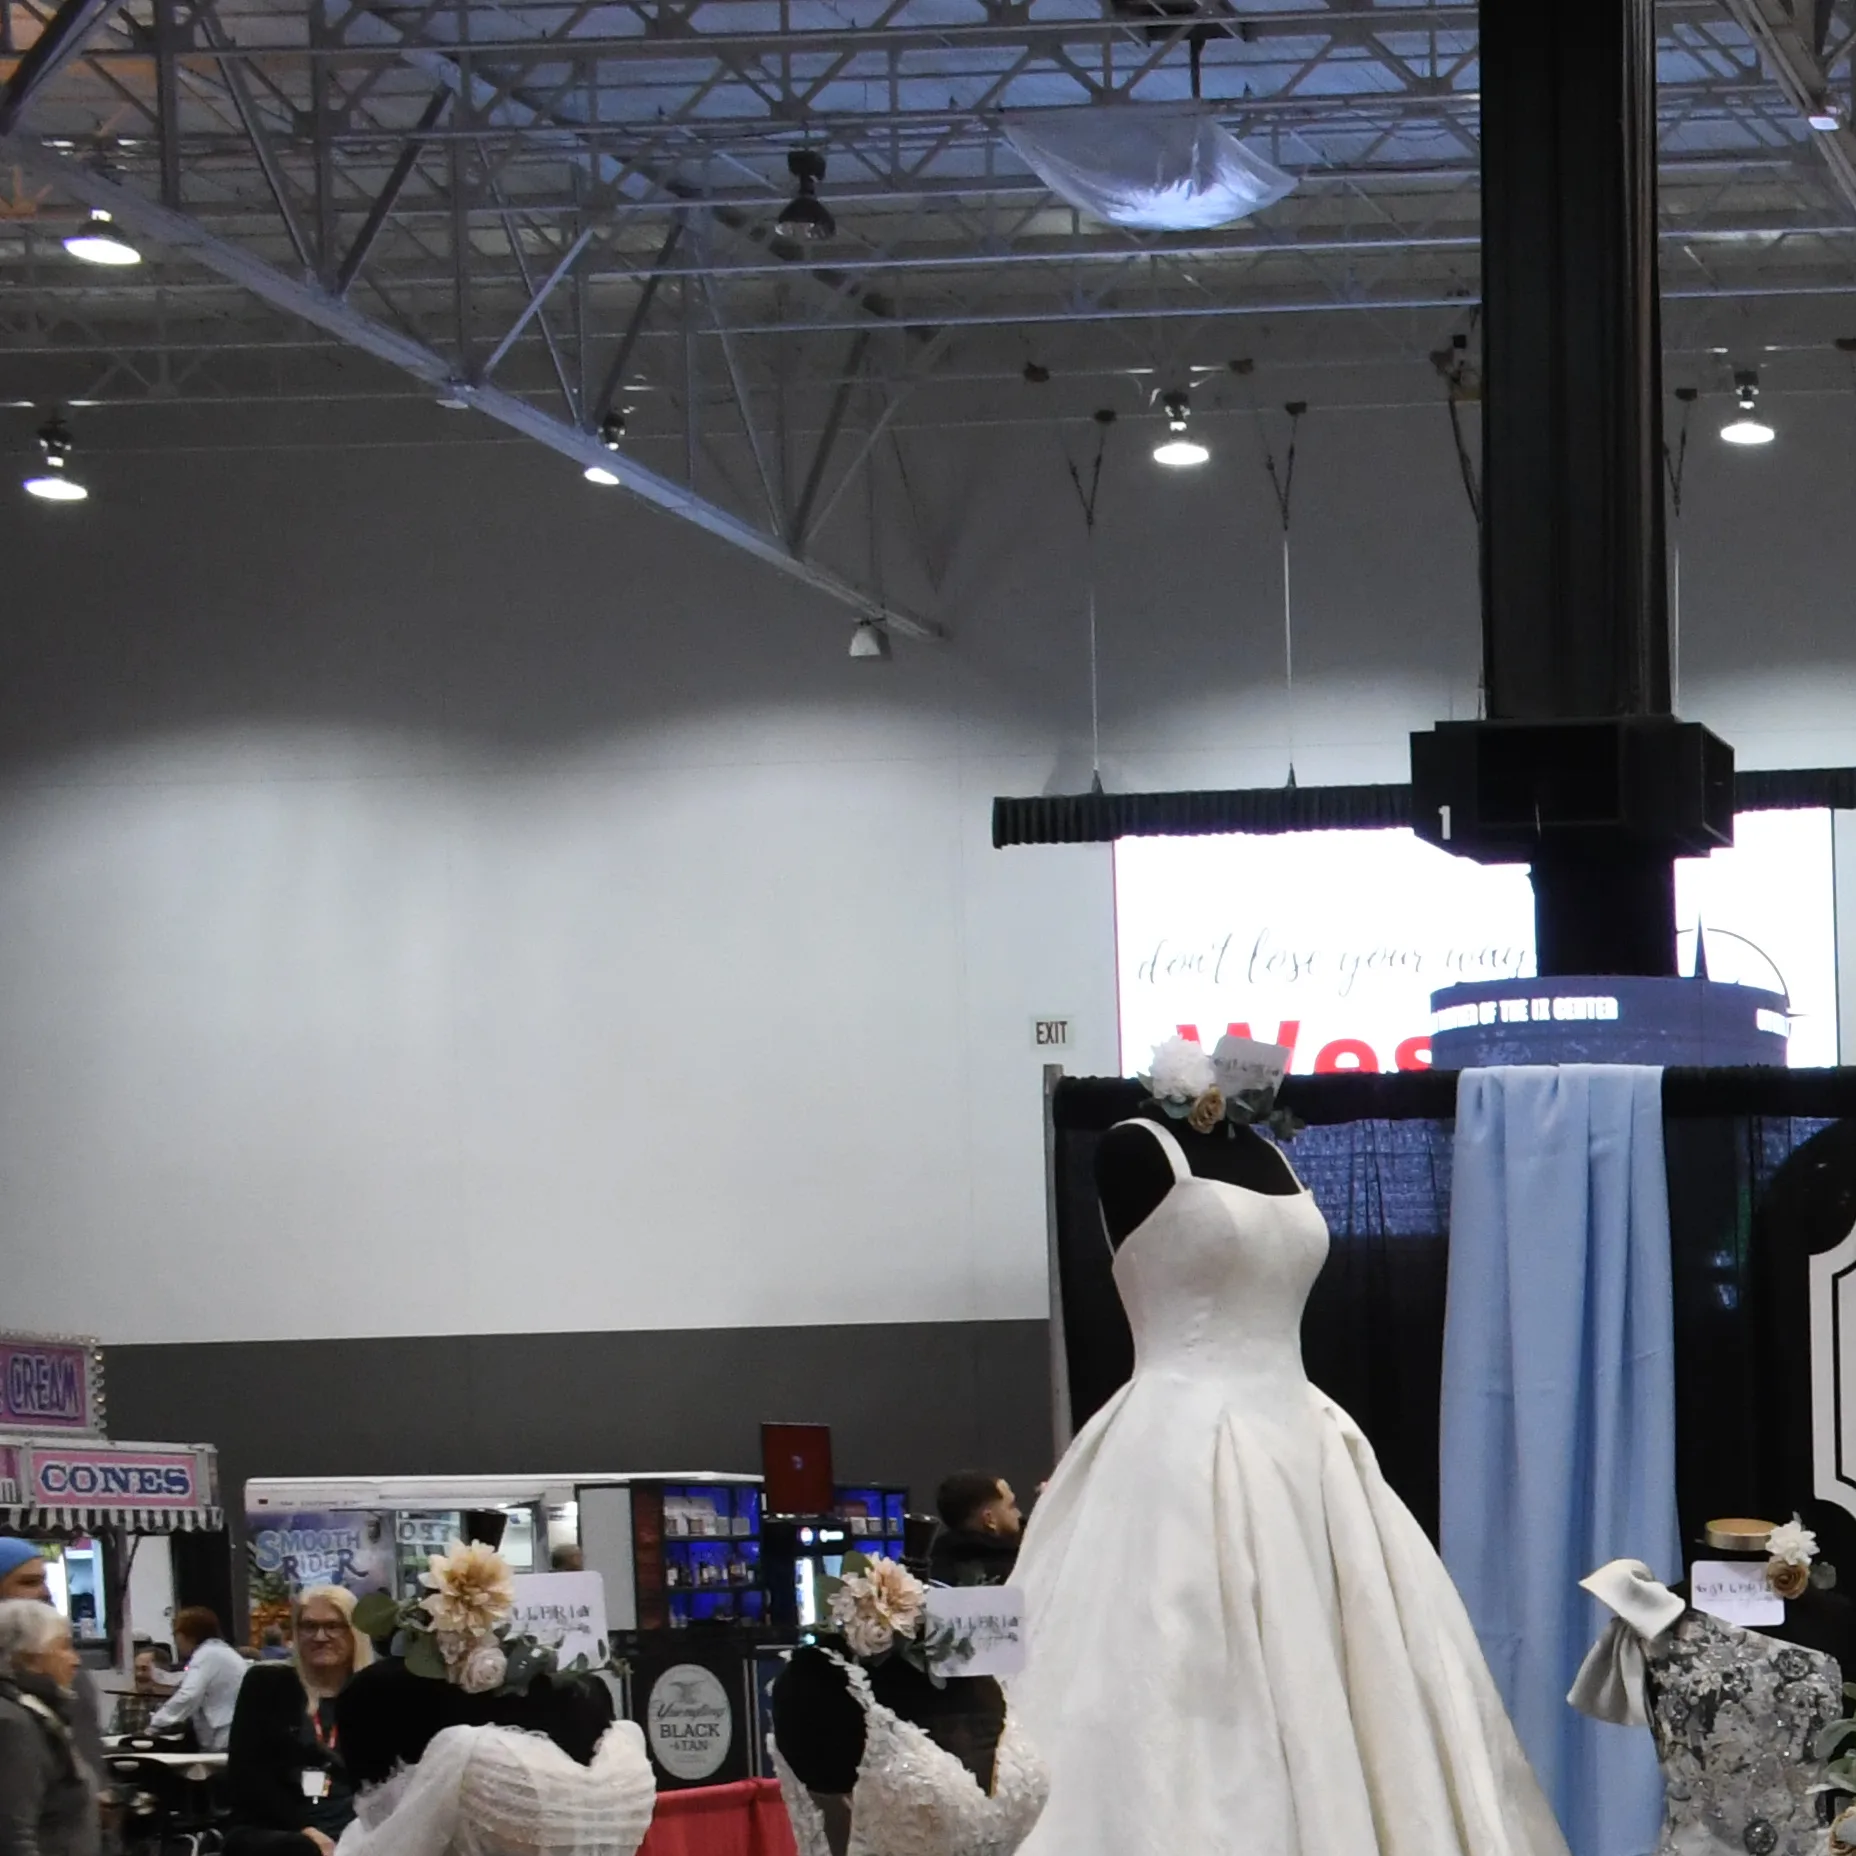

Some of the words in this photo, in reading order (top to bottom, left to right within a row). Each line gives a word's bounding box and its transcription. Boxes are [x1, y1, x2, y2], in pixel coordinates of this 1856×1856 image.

[1438, 805, 1451, 840] 1
[1137, 932, 1233, 984] don't
[1248, 927, 1322, 984] lose
[1338, 946, 1422, 997] your
[1445, 944, 1529, 978] way
[1036, 1020, 1067, 1045] EXIT
[11, 1353, 80, 1415] CREAM
[40, 1463, 191, 1496] CONES
[255, 1529, 361, 1571] SMOOTH
[282, 1549, 369, 1584] RIDER
[659, 1723, 721, 1738] BLACK
